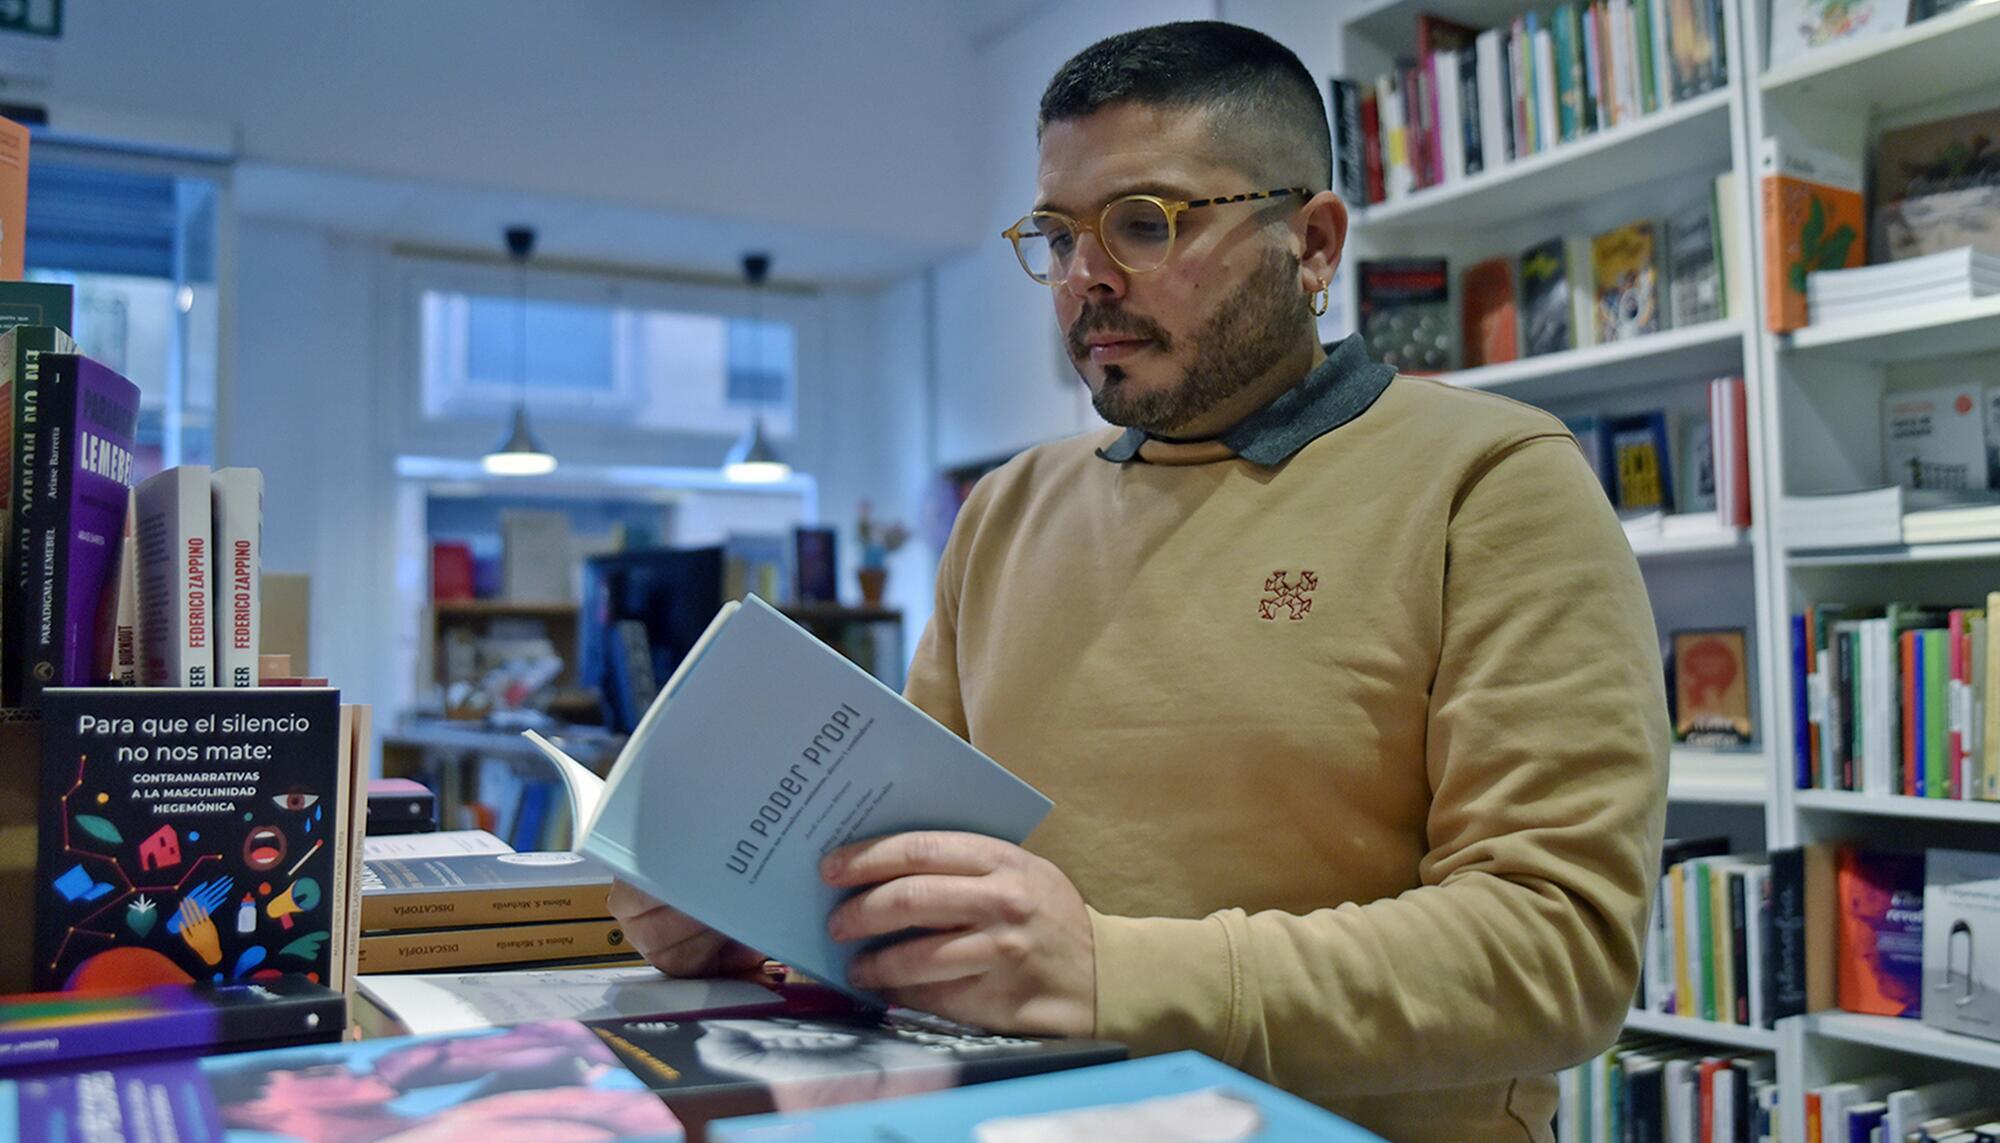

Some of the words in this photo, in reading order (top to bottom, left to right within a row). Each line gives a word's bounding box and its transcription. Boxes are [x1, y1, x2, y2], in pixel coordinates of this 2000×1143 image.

[50, 427, 60, 465] Barretta
[48, 469, 58, 499] Ariase
[45, 527, 56, 576] LEMEBEL
[188, 538, 204, 589] ZAPPINO
[235, 540, 250, 590] ZAPPINO
[40, 579, 53, 644] PARADIGMA
[189, 591, 205, 648] FEDERICO
[235, 593, 250, 649] FEDERICO
[118, 625, 134, 666] BURNOUT
[79, 715, 134, 734] Para
[142, 718, 188, 737] que
[195, 714, 215, 733] el
[222, 713, 310, 733] silencio
[118, 745, 149, 762] no
[156, 745, 199, 761] nos
[206, 743, 272, 760] mate:
[132, 771, 260, 783] CONTRANARRATIVAS
[131, 789, 141, 799] A
[144, 789, 160, 798] LA
[163, 787, 257, 798] MASCULINIDAD
[153, 800, 236, 814] HEGEMÓNICA
[393, 903, 455, 915] DISCATOPÍA
[492, 901, 532, 910] Michavila
[543, 899, 571, 907] Paloma
[398, 944, 459, 958] DISCATOPÍA
[496, 940, 535, 950] Michavila
[546, 936, 574, 945] Paloma
